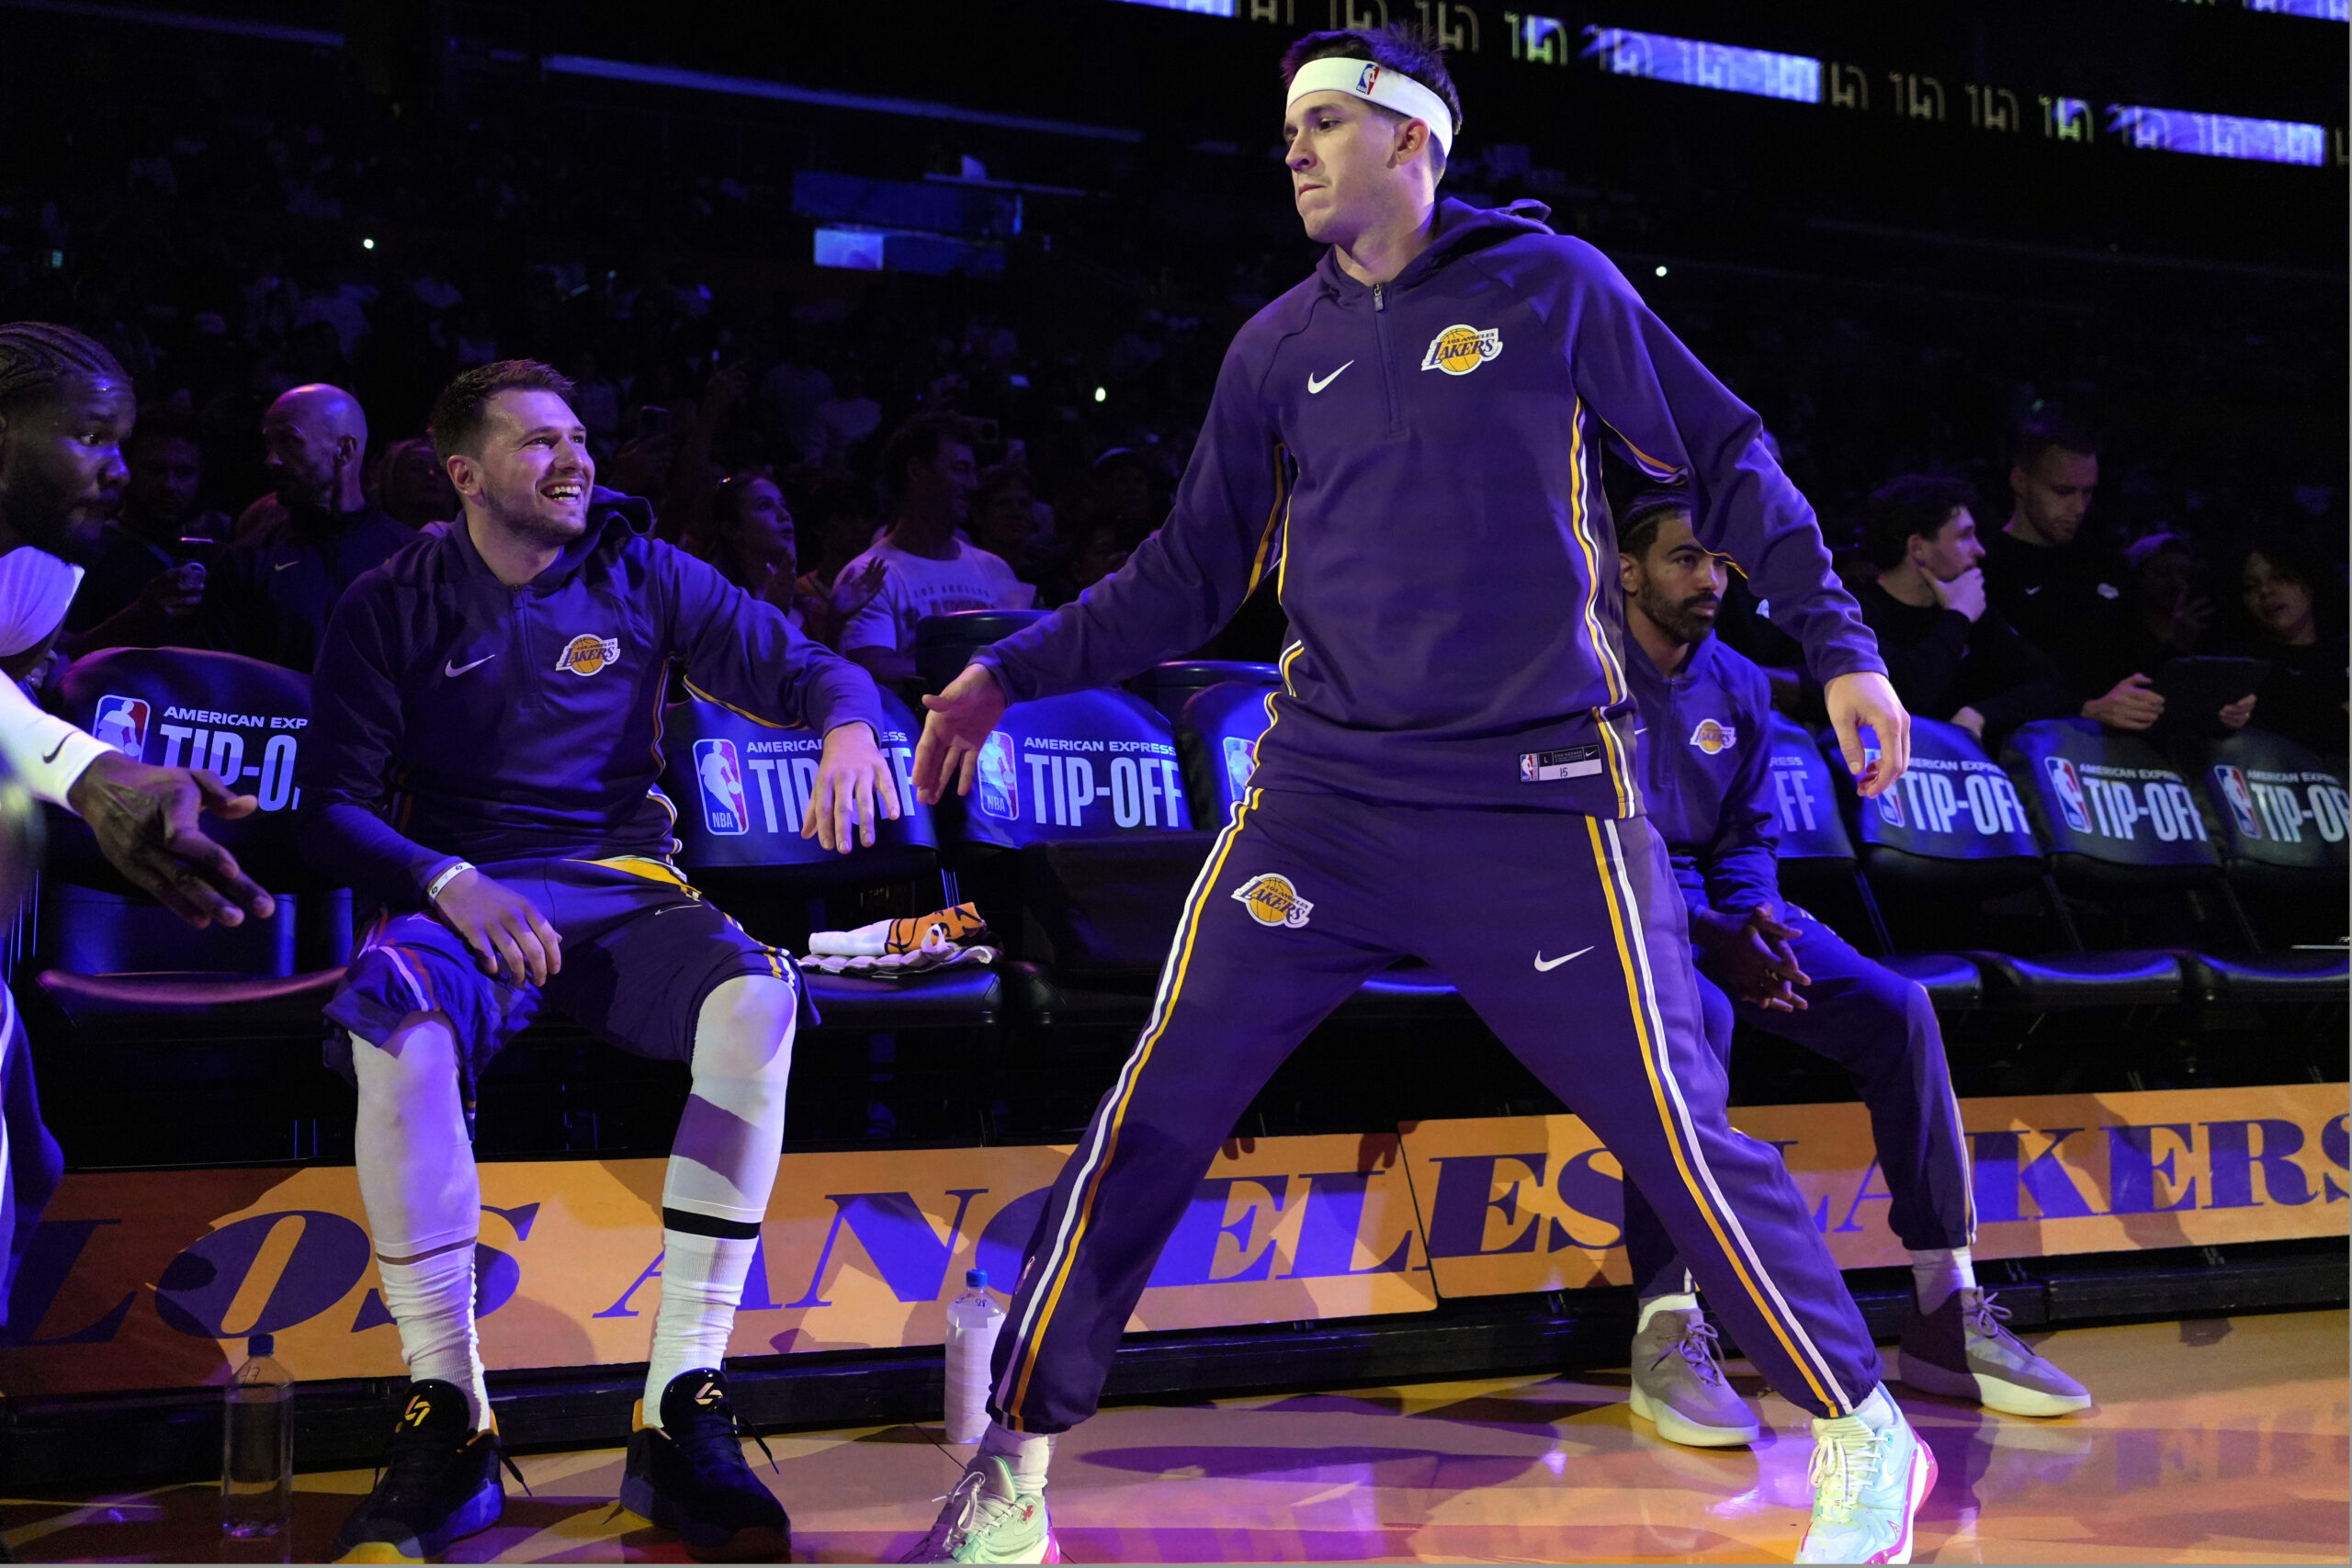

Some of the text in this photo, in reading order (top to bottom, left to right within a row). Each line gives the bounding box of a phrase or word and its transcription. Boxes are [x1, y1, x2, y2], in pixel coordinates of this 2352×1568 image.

[1428, 338, 1498, 366] LAKERS
[561, 647, 616, 668] LAKERS
[164, 705, 265, 728] AMERICAN
[1023, 737, 1177, 757] AMERICAN EXPRESS
[160, 723, 301, 812] TIP-O
[1559, 766, 1568, 778] 15
[1023, 753, 1182, 829] TIP-OFF
[987, 795, 1005, 813] NBA
[712, 812, 733, 829] NBA
[1240, 880, 1306, 925] LAKERS
